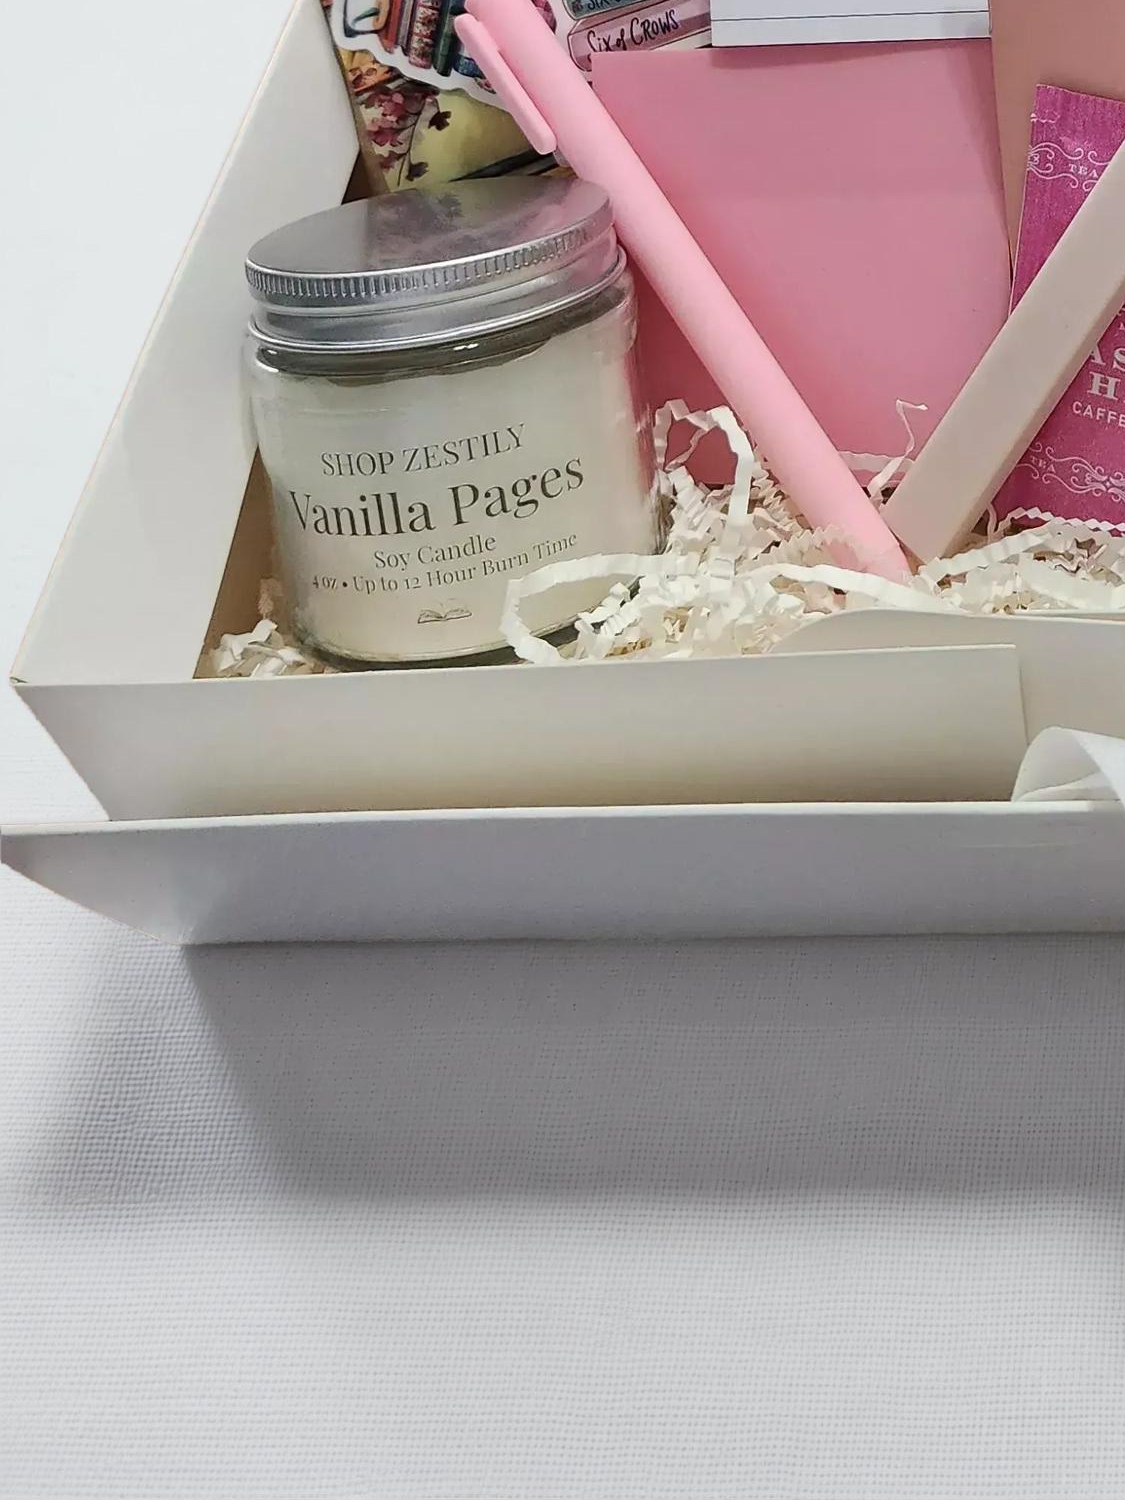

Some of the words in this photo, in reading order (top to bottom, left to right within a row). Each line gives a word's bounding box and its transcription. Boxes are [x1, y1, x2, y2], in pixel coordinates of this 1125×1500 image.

[616, 28, 627, 51] of
[1068, 163, 1099, 179] TEA
[320, 451, 394, 477] SHOP
[402, 422, 525, 473] ZESTILY
[289, 490, 435, 537] Vanilla
[447, 457, 584, 526] Pages
[353, 576, 376, 594] Up
[381, 576, 398, 591] to
[405, 576, 420, 590] 12
[427, 566, 477, 587] Hour
[482, 554, 529, 576] Burn
[533, 533, 578, 559] Time
[374, 550, 411, 571] Soy
[417, 533, 497, 565] Candle
